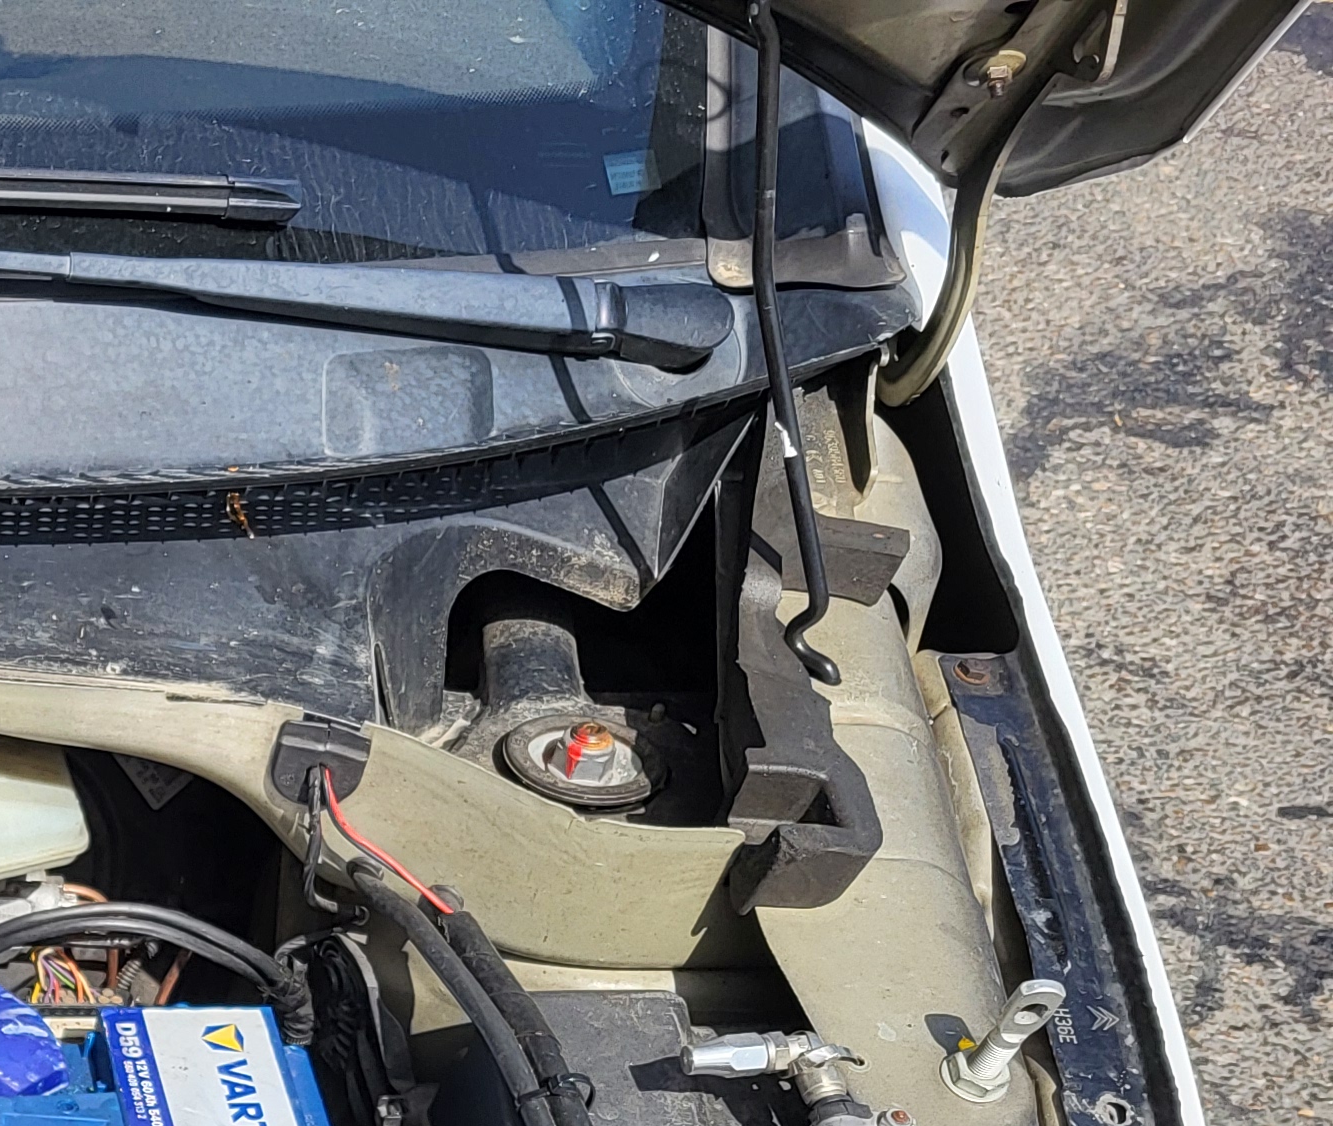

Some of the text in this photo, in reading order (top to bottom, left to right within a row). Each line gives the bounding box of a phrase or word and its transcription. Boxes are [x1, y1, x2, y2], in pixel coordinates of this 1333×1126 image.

[114, 1021, 143, 1059] D59
[135, 1059, 151, 1079] 12V
[1053, 1008, 1078, 1045] H36E
